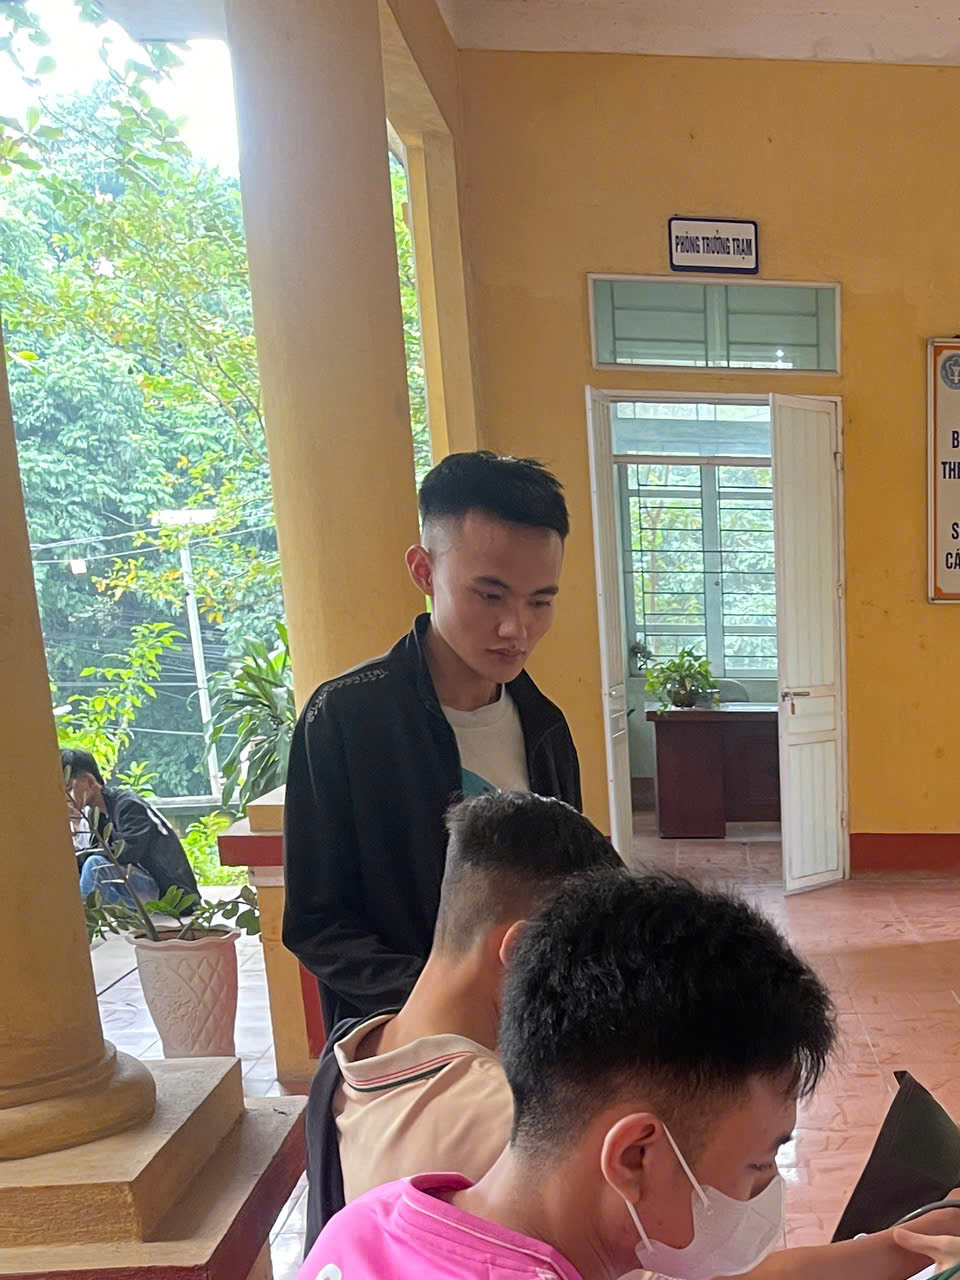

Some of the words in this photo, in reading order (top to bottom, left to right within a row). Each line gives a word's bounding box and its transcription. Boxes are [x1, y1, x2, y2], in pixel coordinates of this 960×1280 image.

[675, 231, 700, 254] PHÒNG
[702, 229, 731, 255] TRƯỞNG
[732, 237, 753, 260] TRẠM
